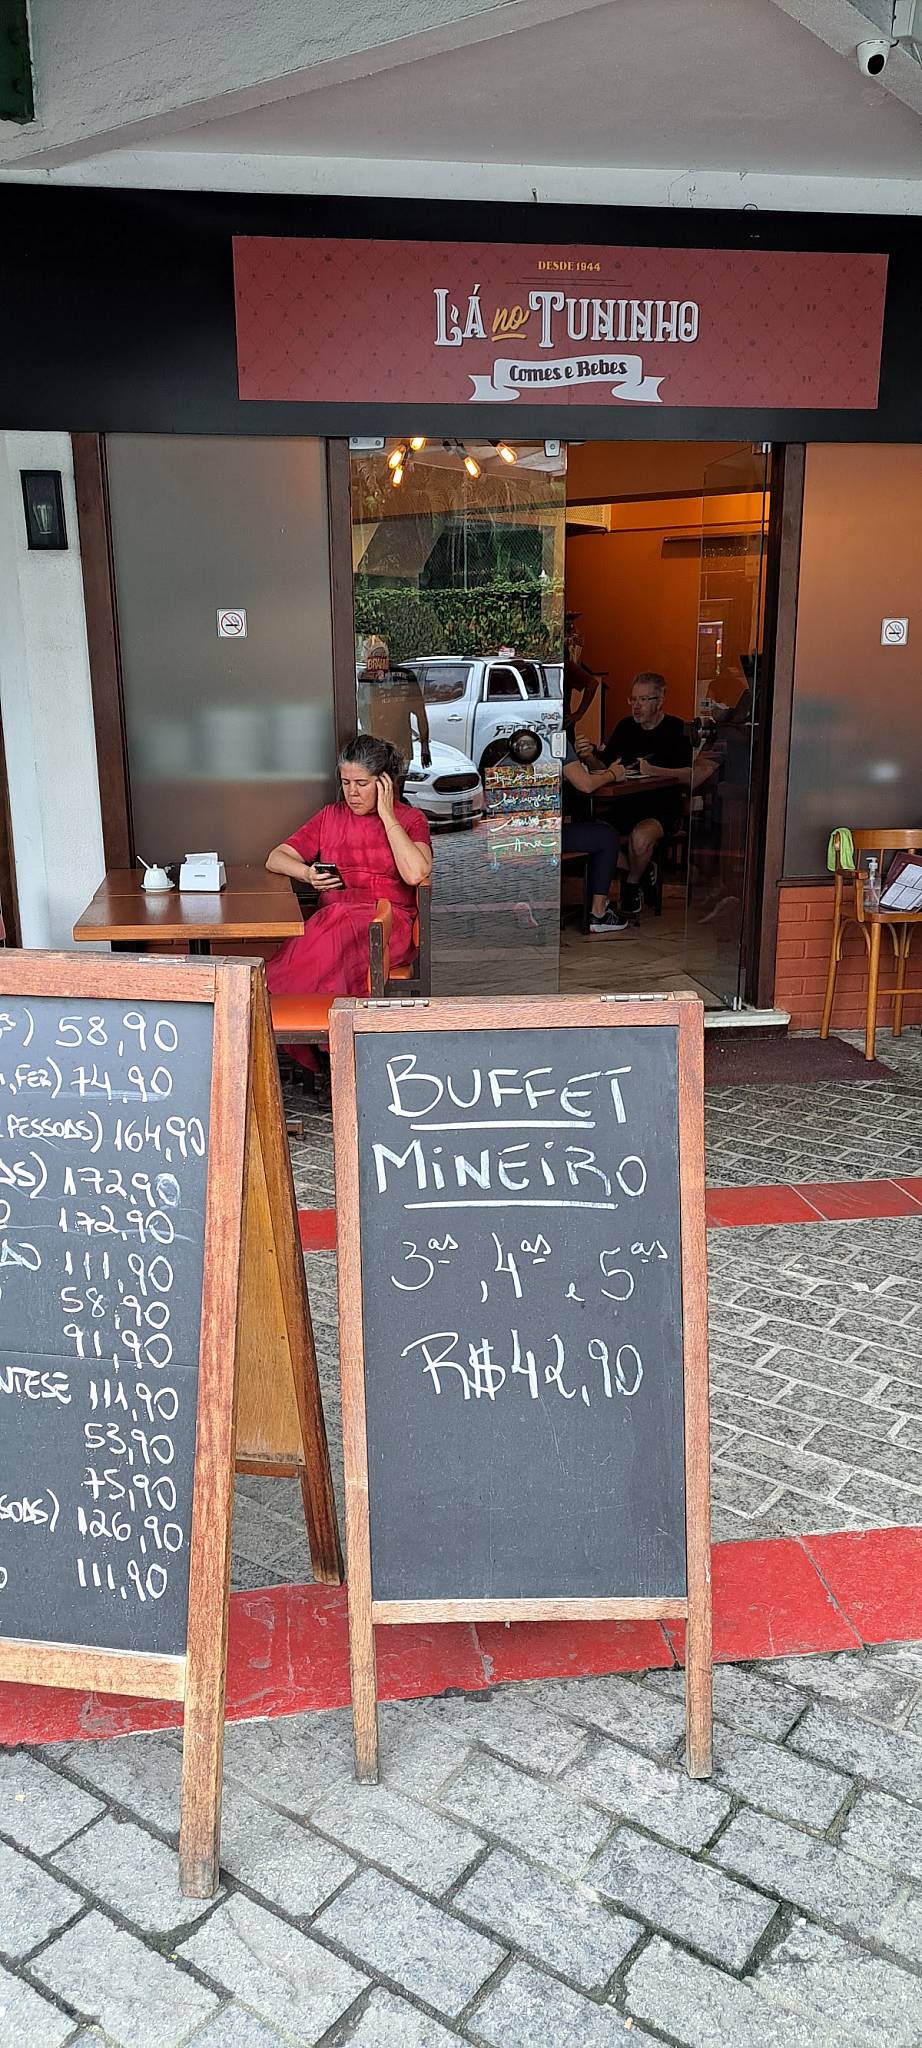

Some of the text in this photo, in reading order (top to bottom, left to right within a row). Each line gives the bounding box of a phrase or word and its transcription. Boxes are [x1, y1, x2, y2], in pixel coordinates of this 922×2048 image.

[538, 260, 601, 272] DESDE 1944
[433, 283, 700, 348] LÁ no TUNINHO
[509, 359, 628, 382] Comes e Bebes
[55, 1011, 178, 1056] 58,90
[71, 1063, 173, 1103] 74,90
[386, 1053, 633, 1123] BUFFET
[114, 1116, 205, 1162] 164,90
[64, 1166, 181, 1207] 172,90
[59, 1204, 175, 1244] 172,90
[65, 1250, 174, 1296] 111,90
[60, 1287, 170, 1330] 58,90
[63, 1323, 173, 1369] 91,90
[90, 1378, 179, 1422] 111,90
[84, 1423, 174, 1465] 53,90
[81, 1467, 177, 1511] 75,90
[77, 1506, 183, 1553] 126,90
[77, 1558, 168, 1602] 111,90
